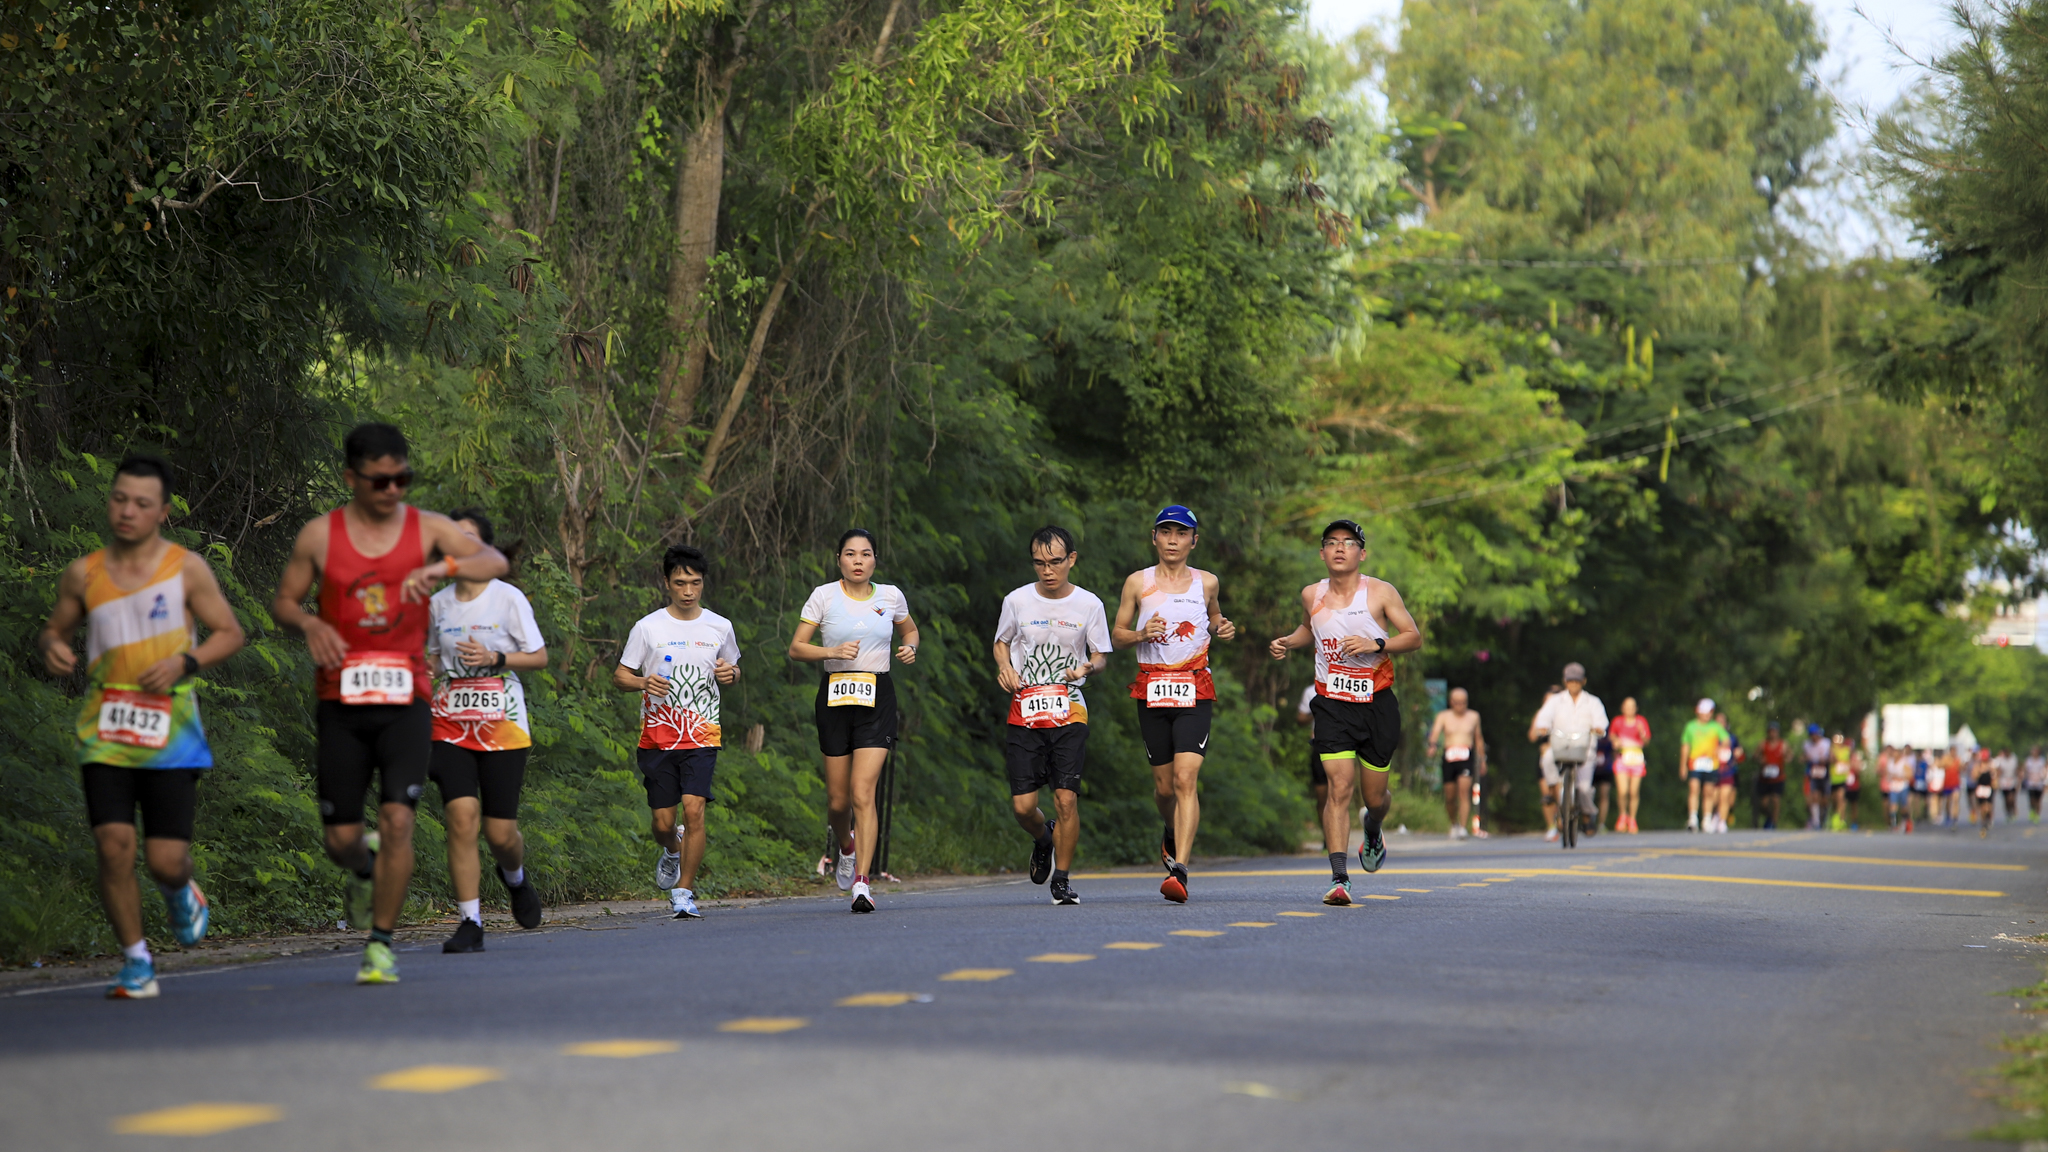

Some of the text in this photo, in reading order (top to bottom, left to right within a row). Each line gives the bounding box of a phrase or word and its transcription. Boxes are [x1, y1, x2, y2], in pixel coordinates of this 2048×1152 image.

[1321, 637, 1338, 651] FM
[351, 671, 405, 688] 41098
[1332, 676, 1368, 693] 41456
[833, 682, 872, 696] 40049
[1154, 684, 1189, 697] 41142
[453, 692, 499, 708] 20265
[1028, 696, 1063, 712] 41574
[107, 707, 162, 732] 41432
